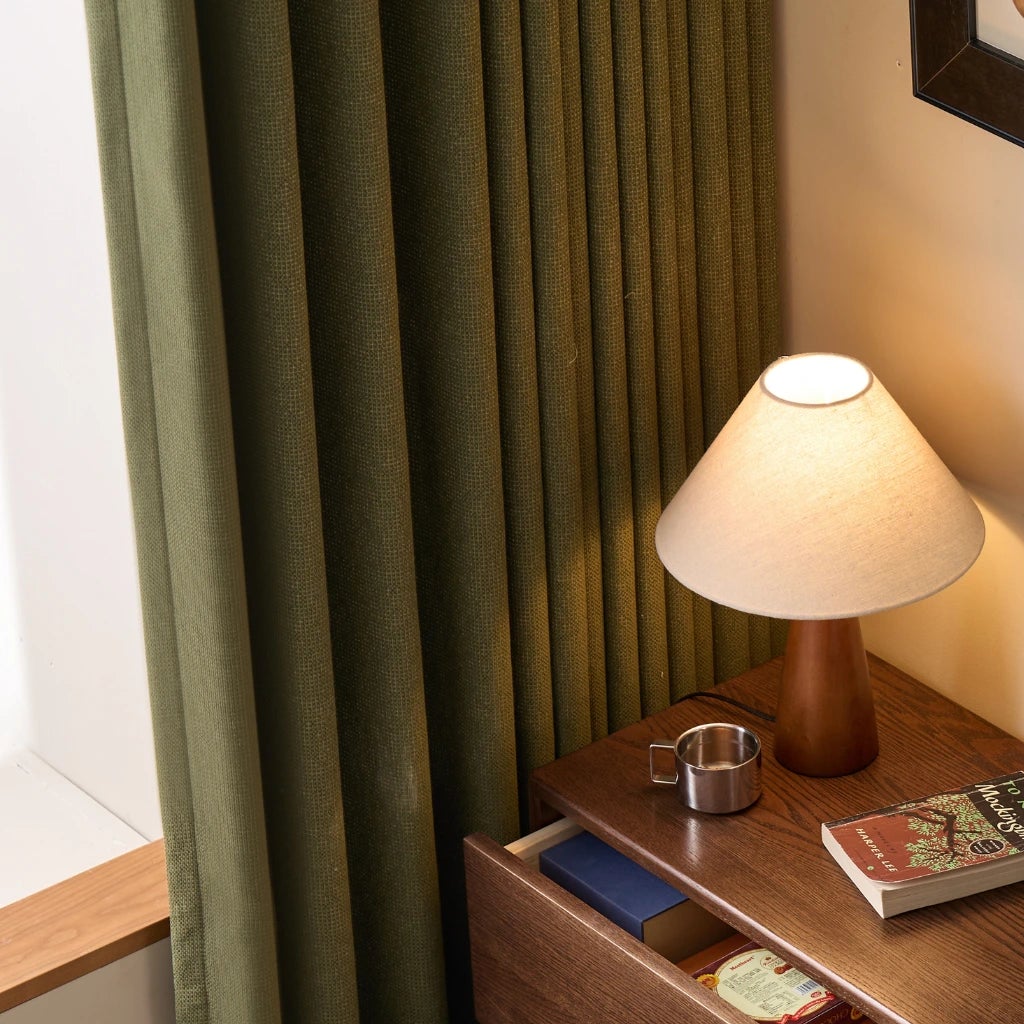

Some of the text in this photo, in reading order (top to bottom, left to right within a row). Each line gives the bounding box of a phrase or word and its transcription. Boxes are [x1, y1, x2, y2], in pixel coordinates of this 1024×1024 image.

[1002, 780, 1021, 795] TO
[855, 828, 884, 860] HARPER
[881, 860, 898, 873] LEE
